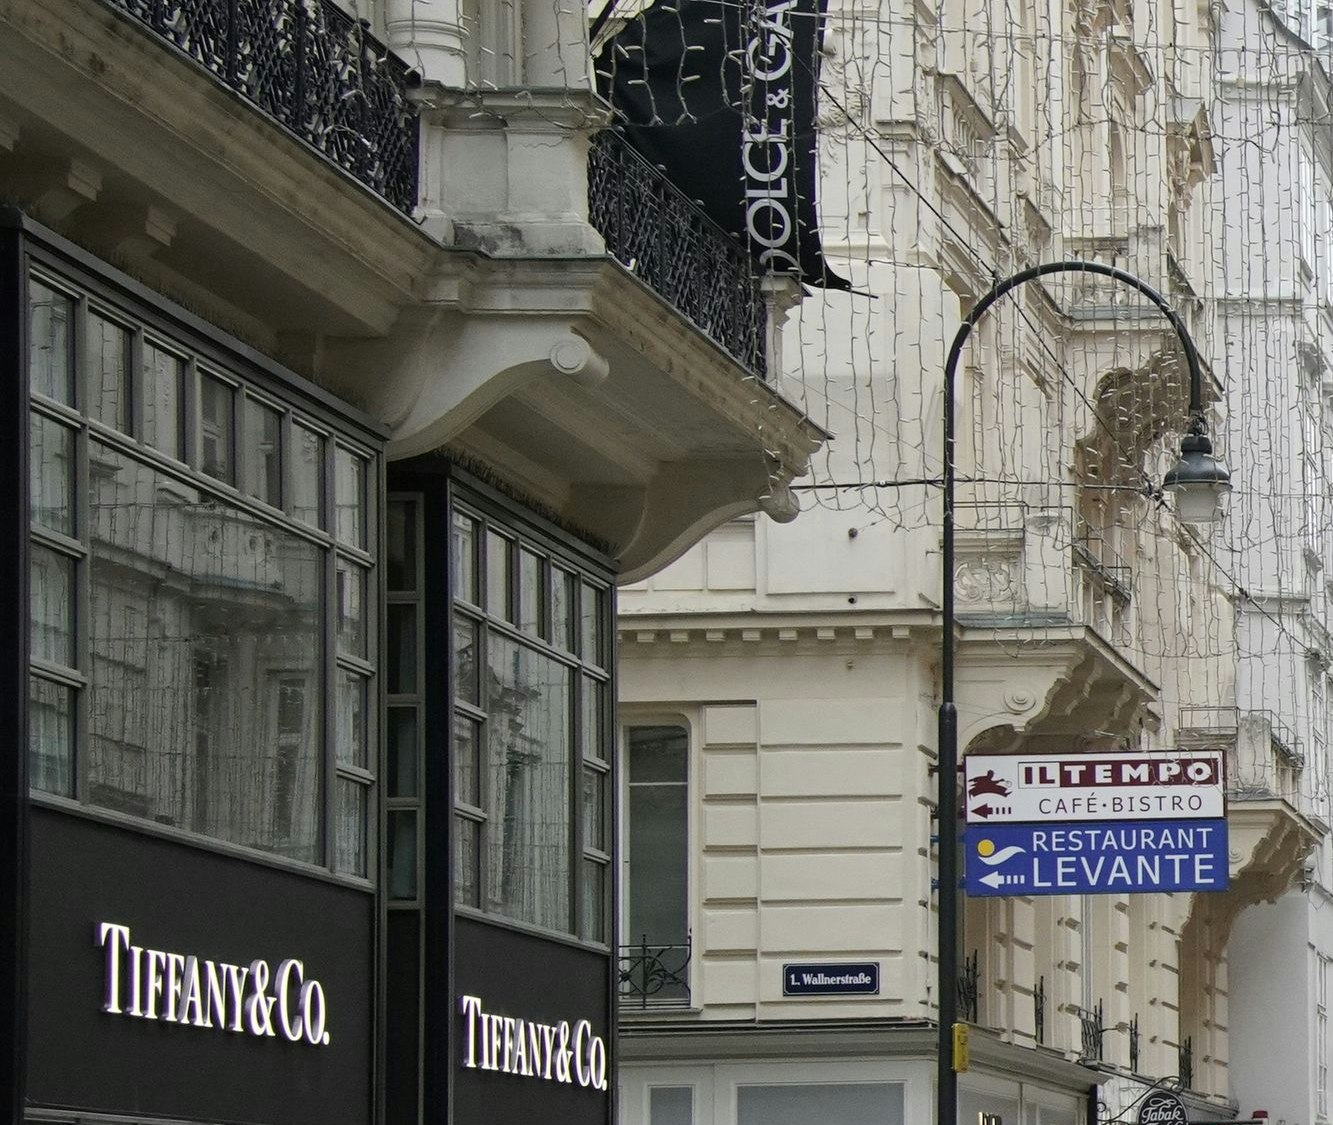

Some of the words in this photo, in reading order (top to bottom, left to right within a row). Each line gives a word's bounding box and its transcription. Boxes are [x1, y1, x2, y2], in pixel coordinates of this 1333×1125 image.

[766, 88, 789, 108] &
[742, 118, 806, 276] DOLCE
[1024, 766, 1055, 785] IL
[1063, 761, 1213, 785] TEMPO
[1033, 828, 1213, 852] RESTAURANT
[1033, 853, 1216, 887] LEVANTE
[803, 973, 871, 985] Wallnerstraße
[1141, 1105, 1184, 1122] Tabak
